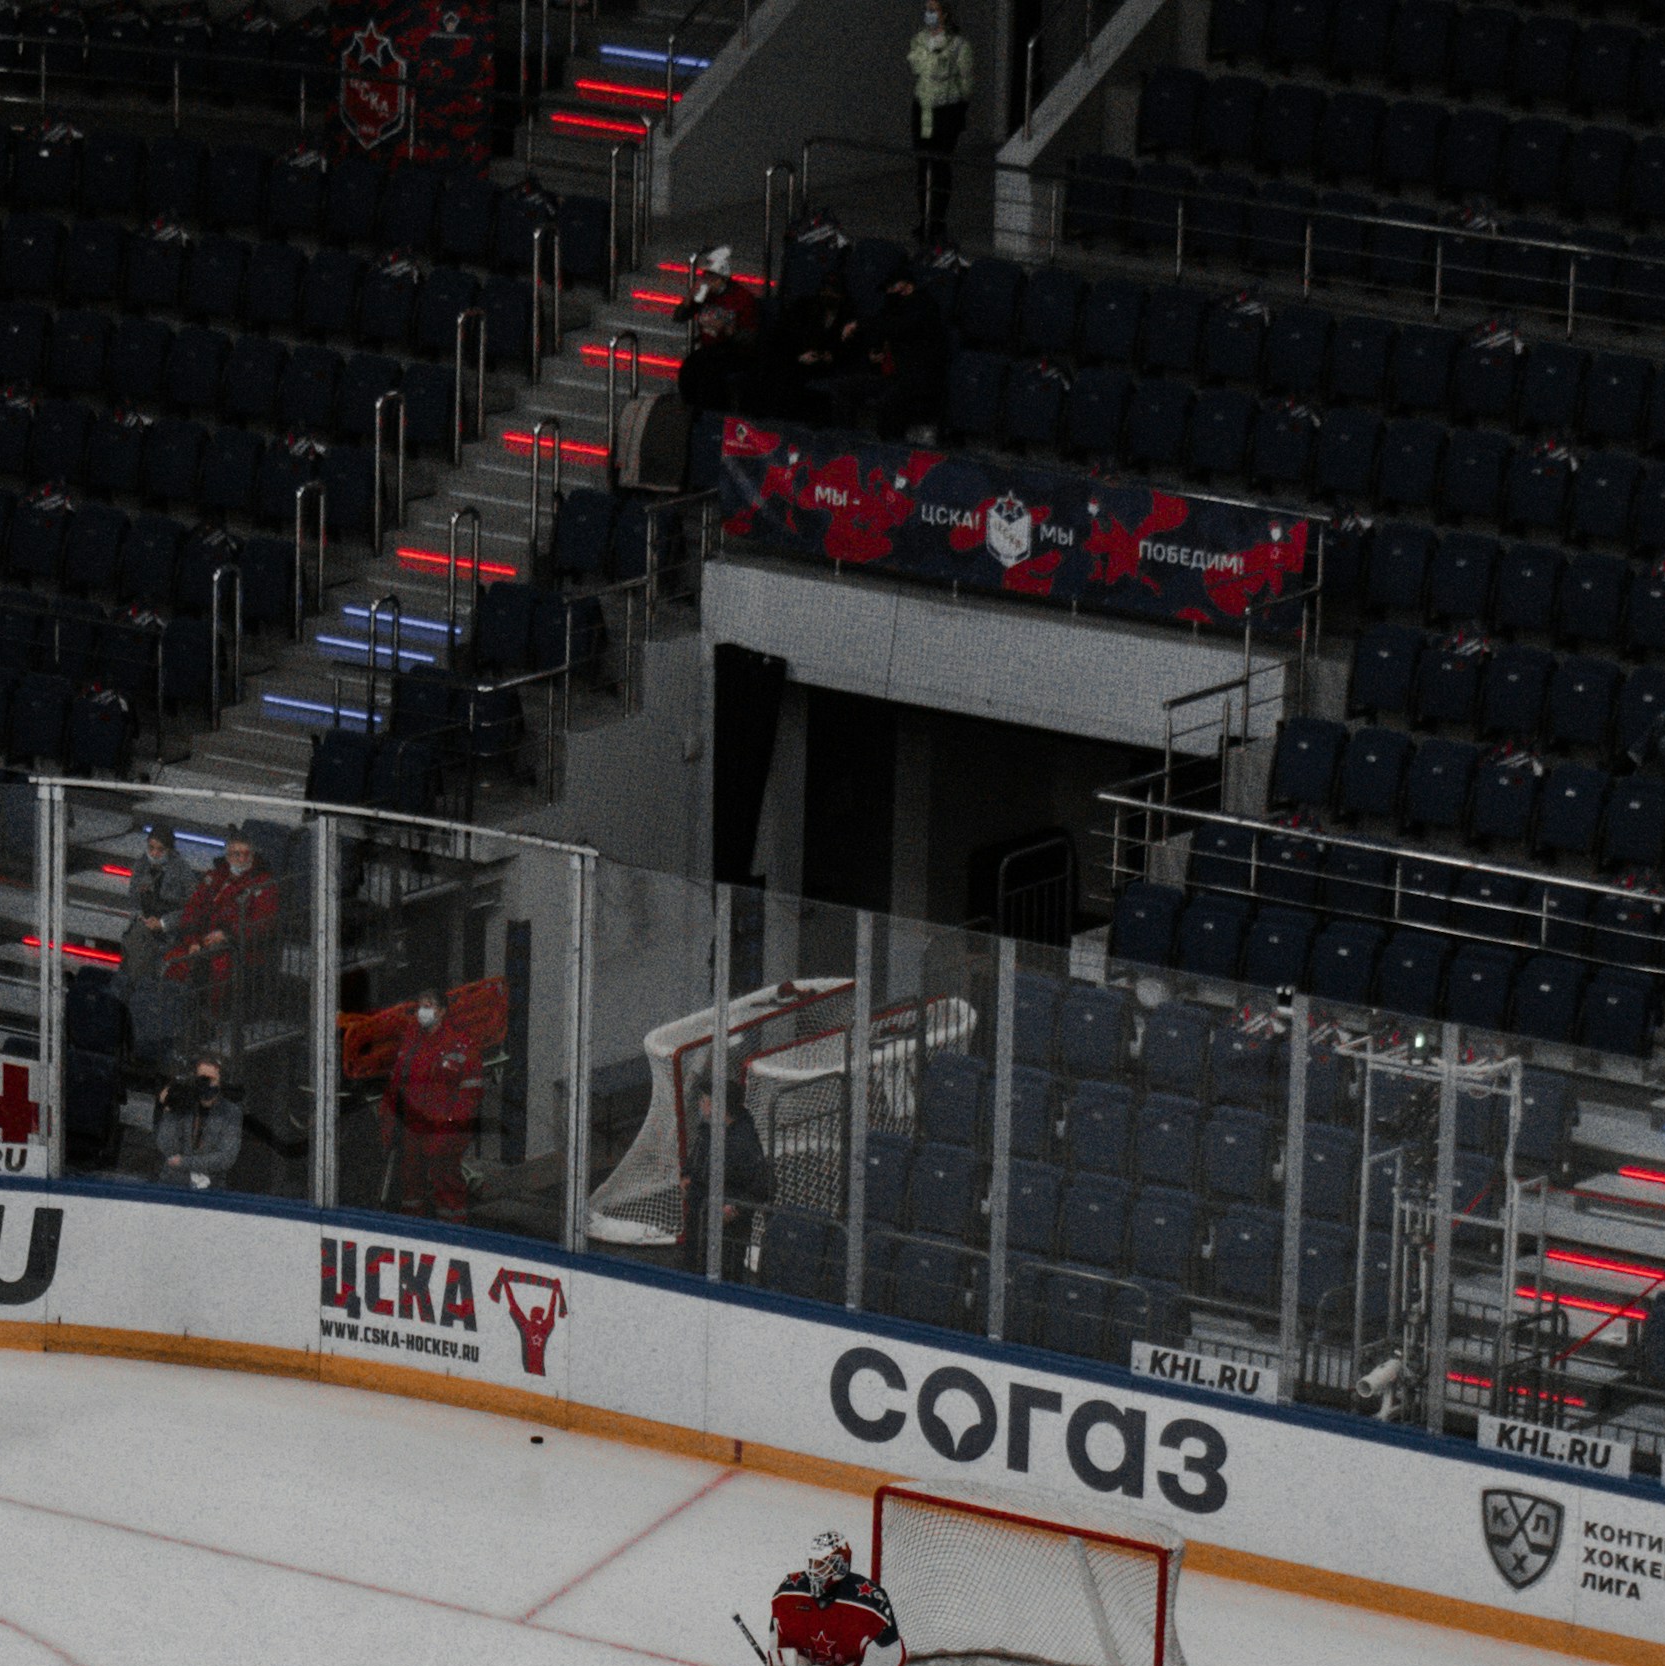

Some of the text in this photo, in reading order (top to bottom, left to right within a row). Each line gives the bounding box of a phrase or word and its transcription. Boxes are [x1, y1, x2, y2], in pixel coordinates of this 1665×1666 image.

[814, 484, 847, 507] МЫ
[921, 503, 980, 530] ЦСКА!
[1040, 523, 1074, 547] МЫ
[1139, 540, 1244, 574] ПОБЕДИМ!
[320, 1237, 478, 1333] ЦСКА
[320, 1318, 480, 1364] WWW.CSKA-HOCKEY.RU
[1148, 1350, 1261, 1396] KHL.RU
[1496, 1423, 1612, 1469] KHL.RU
[1581, 1572, 1641, 1600] ЛИГА
